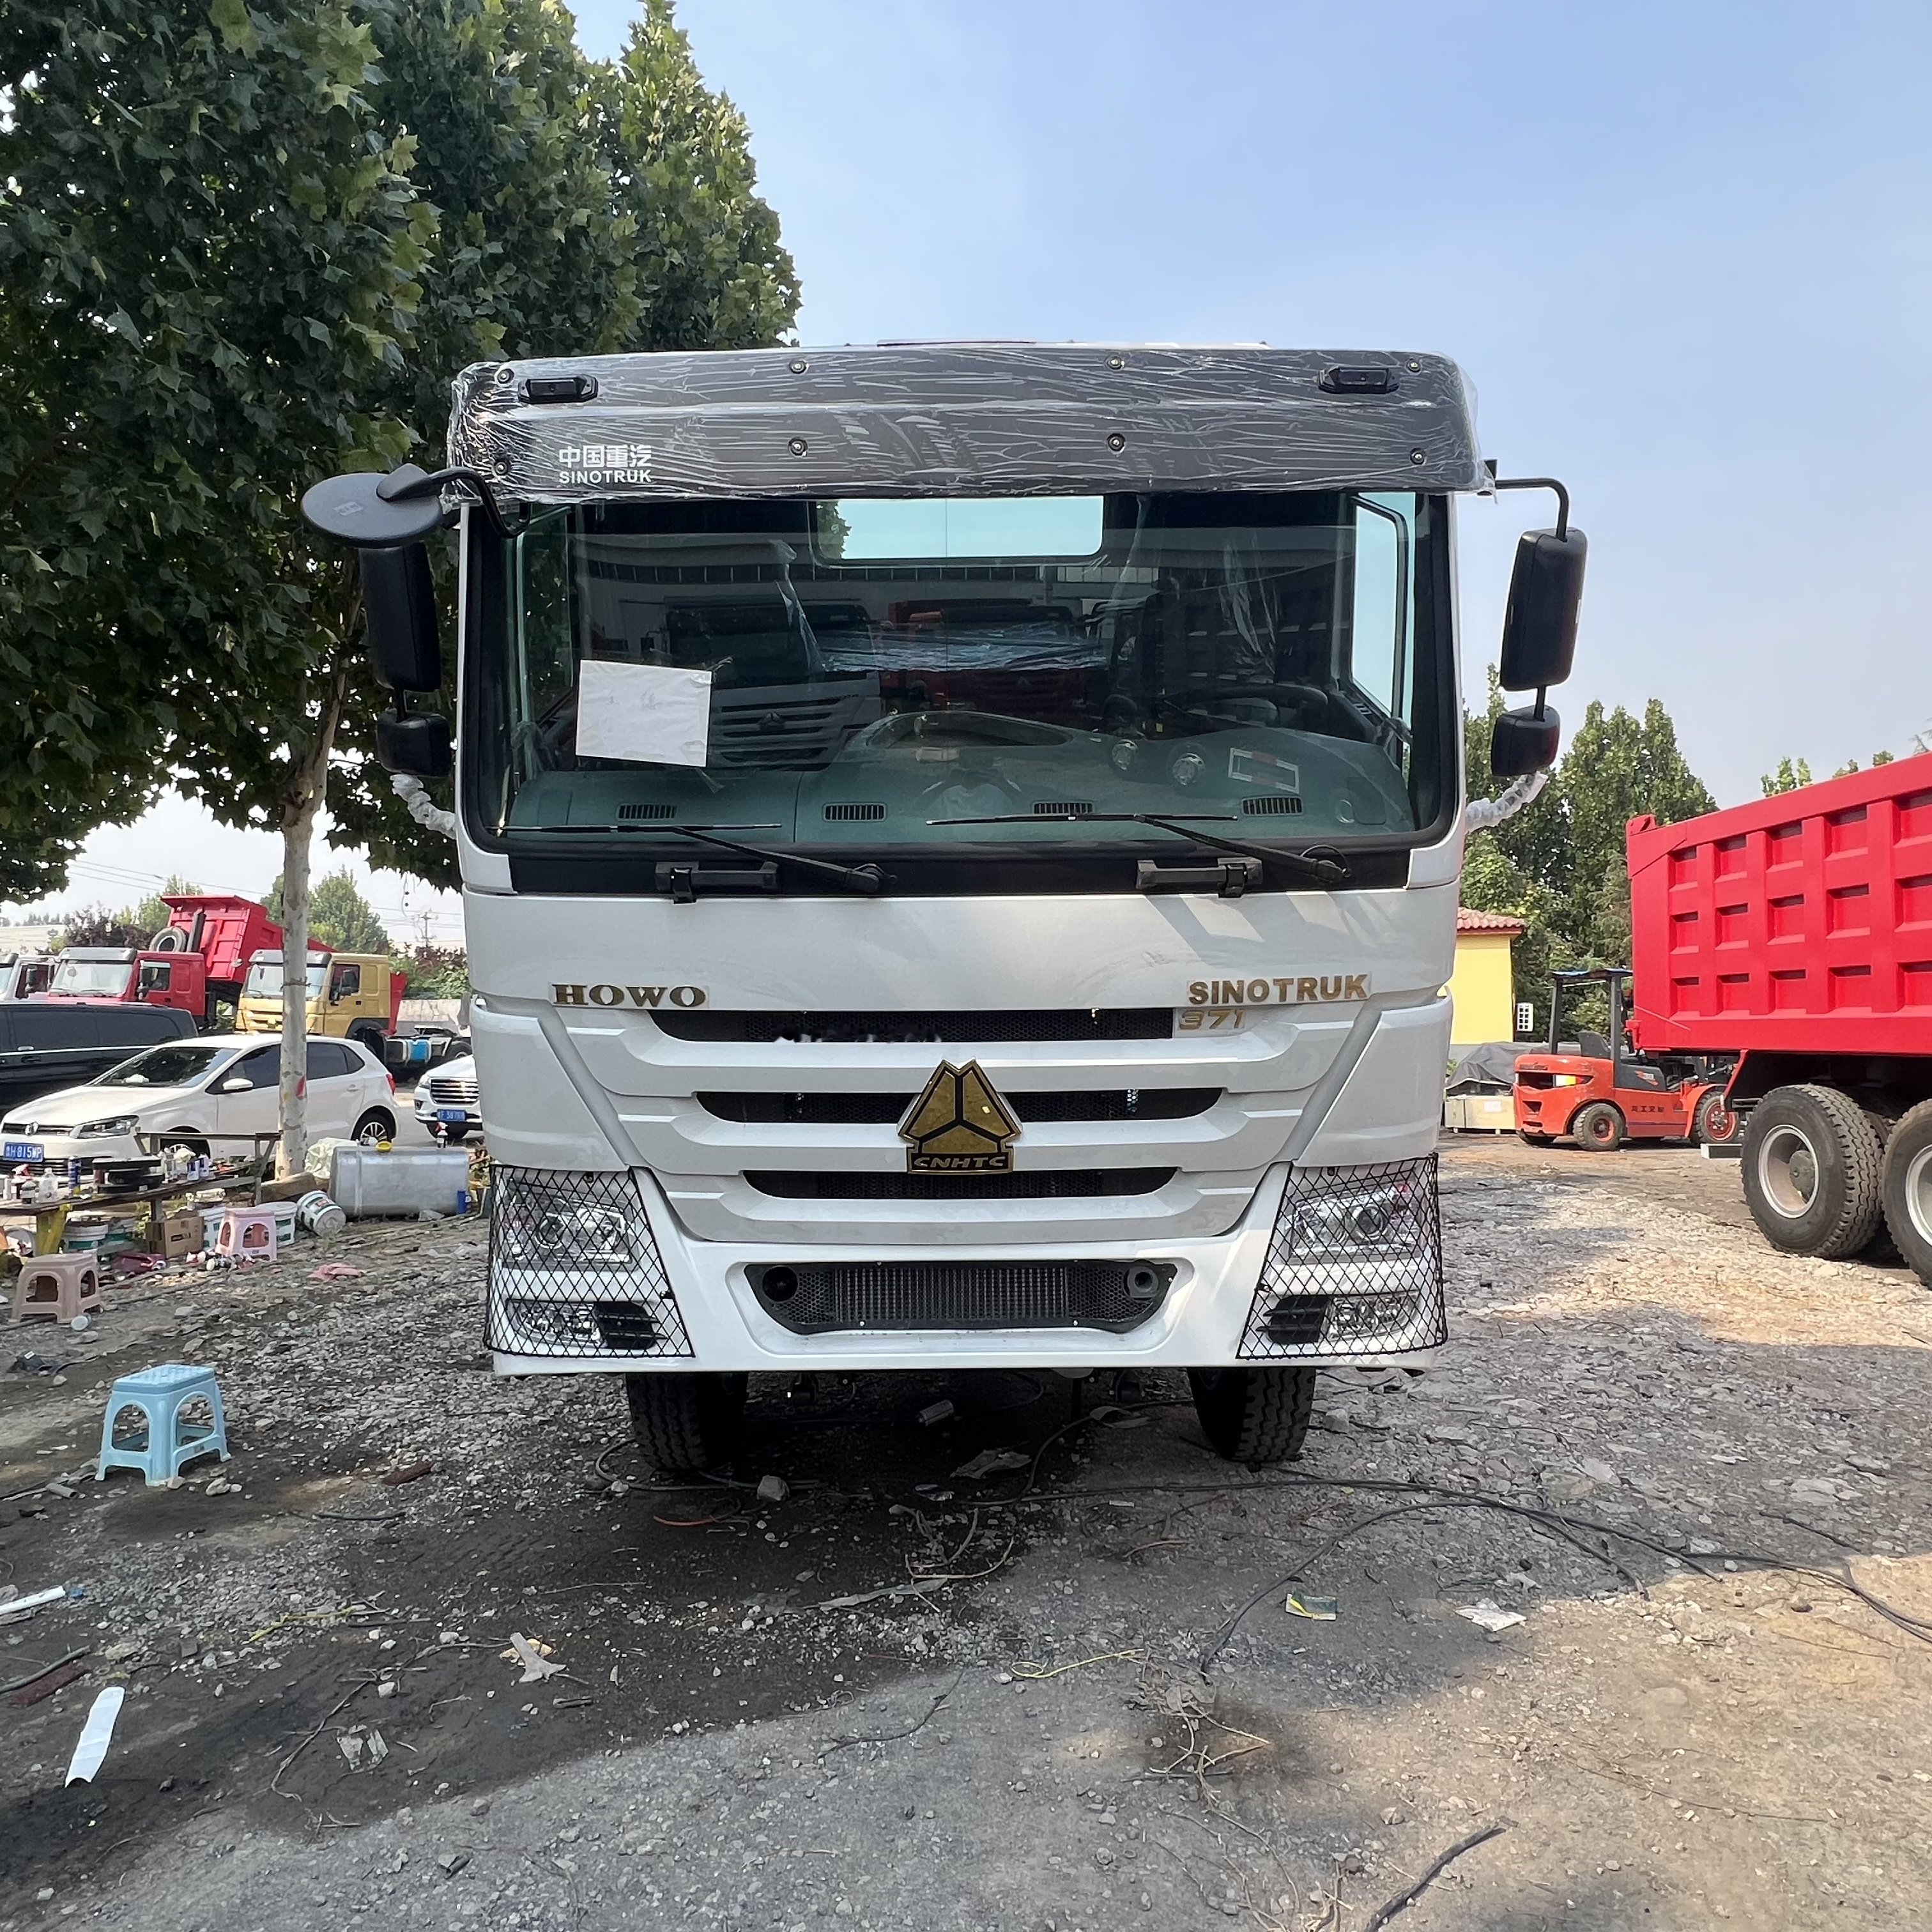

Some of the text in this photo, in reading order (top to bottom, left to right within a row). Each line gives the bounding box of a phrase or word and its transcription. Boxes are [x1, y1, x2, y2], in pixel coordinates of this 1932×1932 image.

[559, 445, 652, 468] 中国重汽
[559, 470, 652, 484] SINOTRUK
[552, 984, 706, 1008] HOWO
[1188, 974, 1368, 1004] SINOTRUK
[1179, 1009, 1245, 1029] 371
[914, 1156, 1006, 1169] CNHTC
